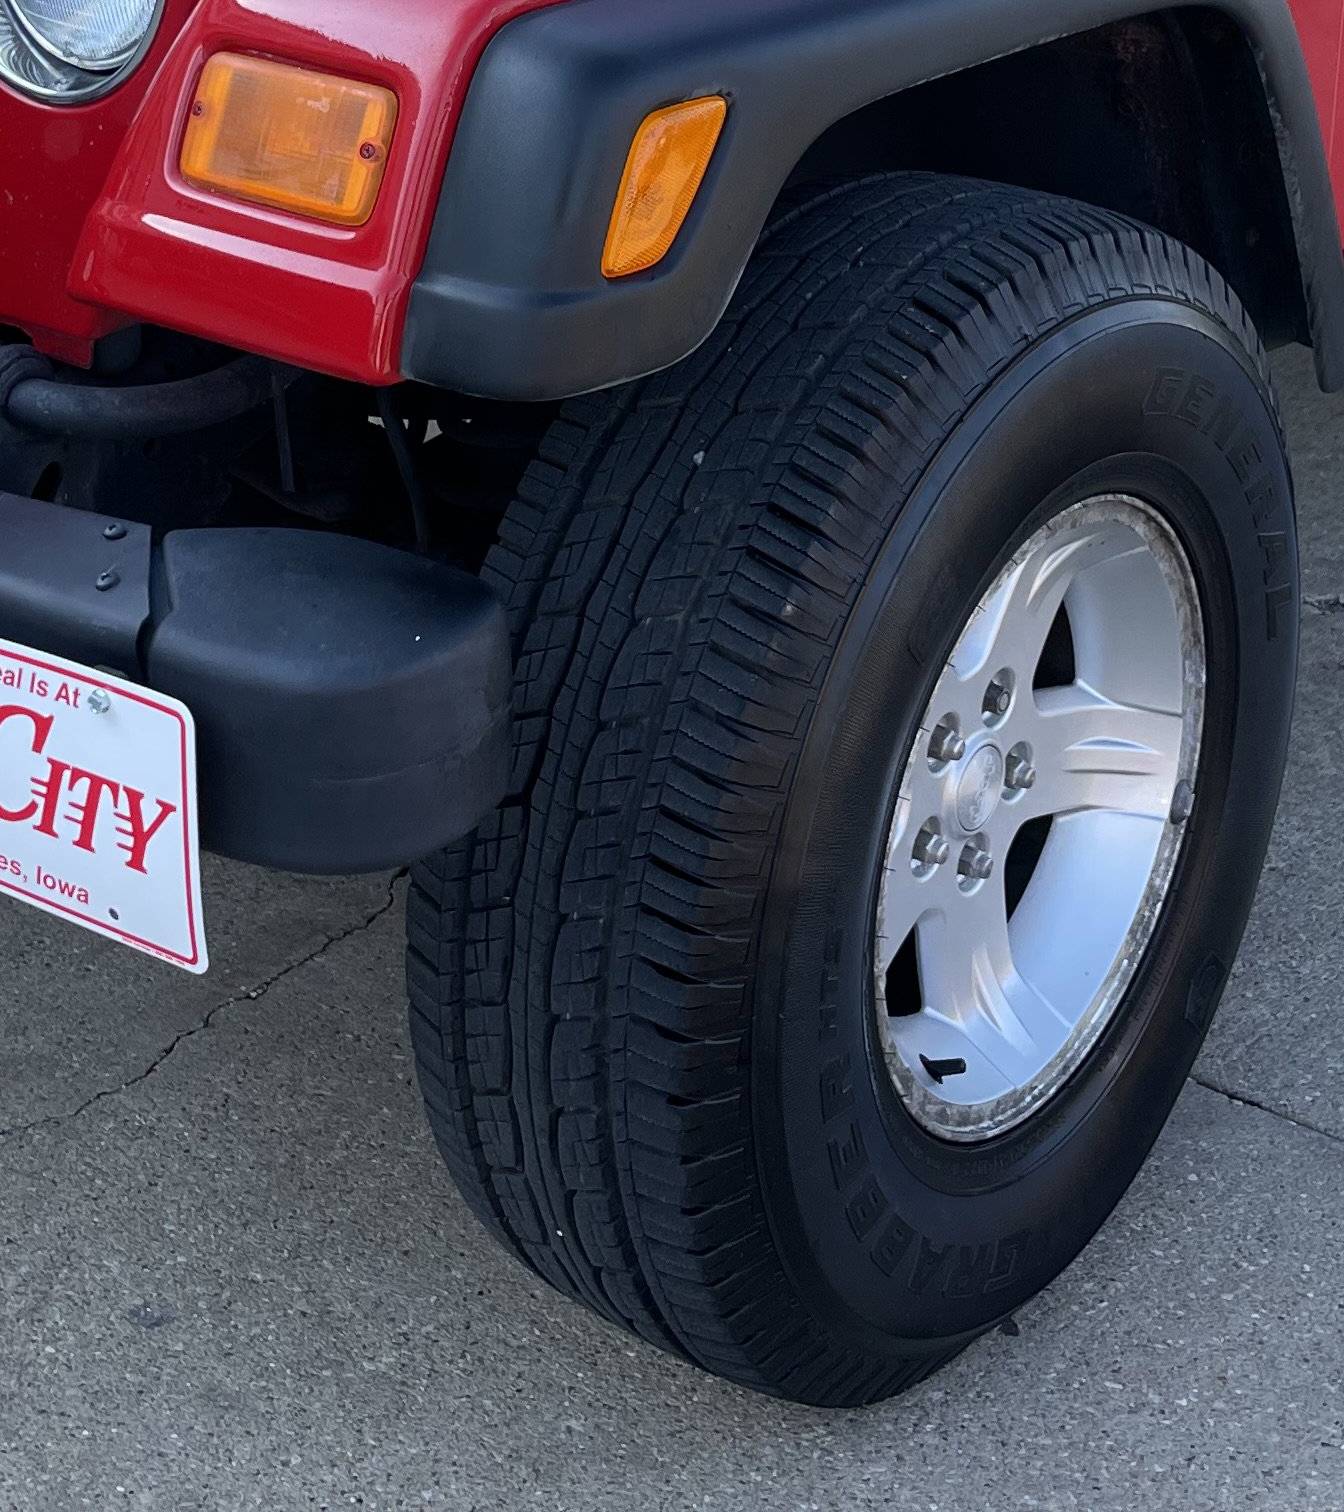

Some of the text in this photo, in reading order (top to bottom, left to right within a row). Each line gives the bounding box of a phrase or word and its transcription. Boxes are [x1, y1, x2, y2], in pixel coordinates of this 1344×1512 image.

[30, 672, 48, 696] Is
[55, 680, 81, 709] At
[37, 864, 90, 904] Iowa
